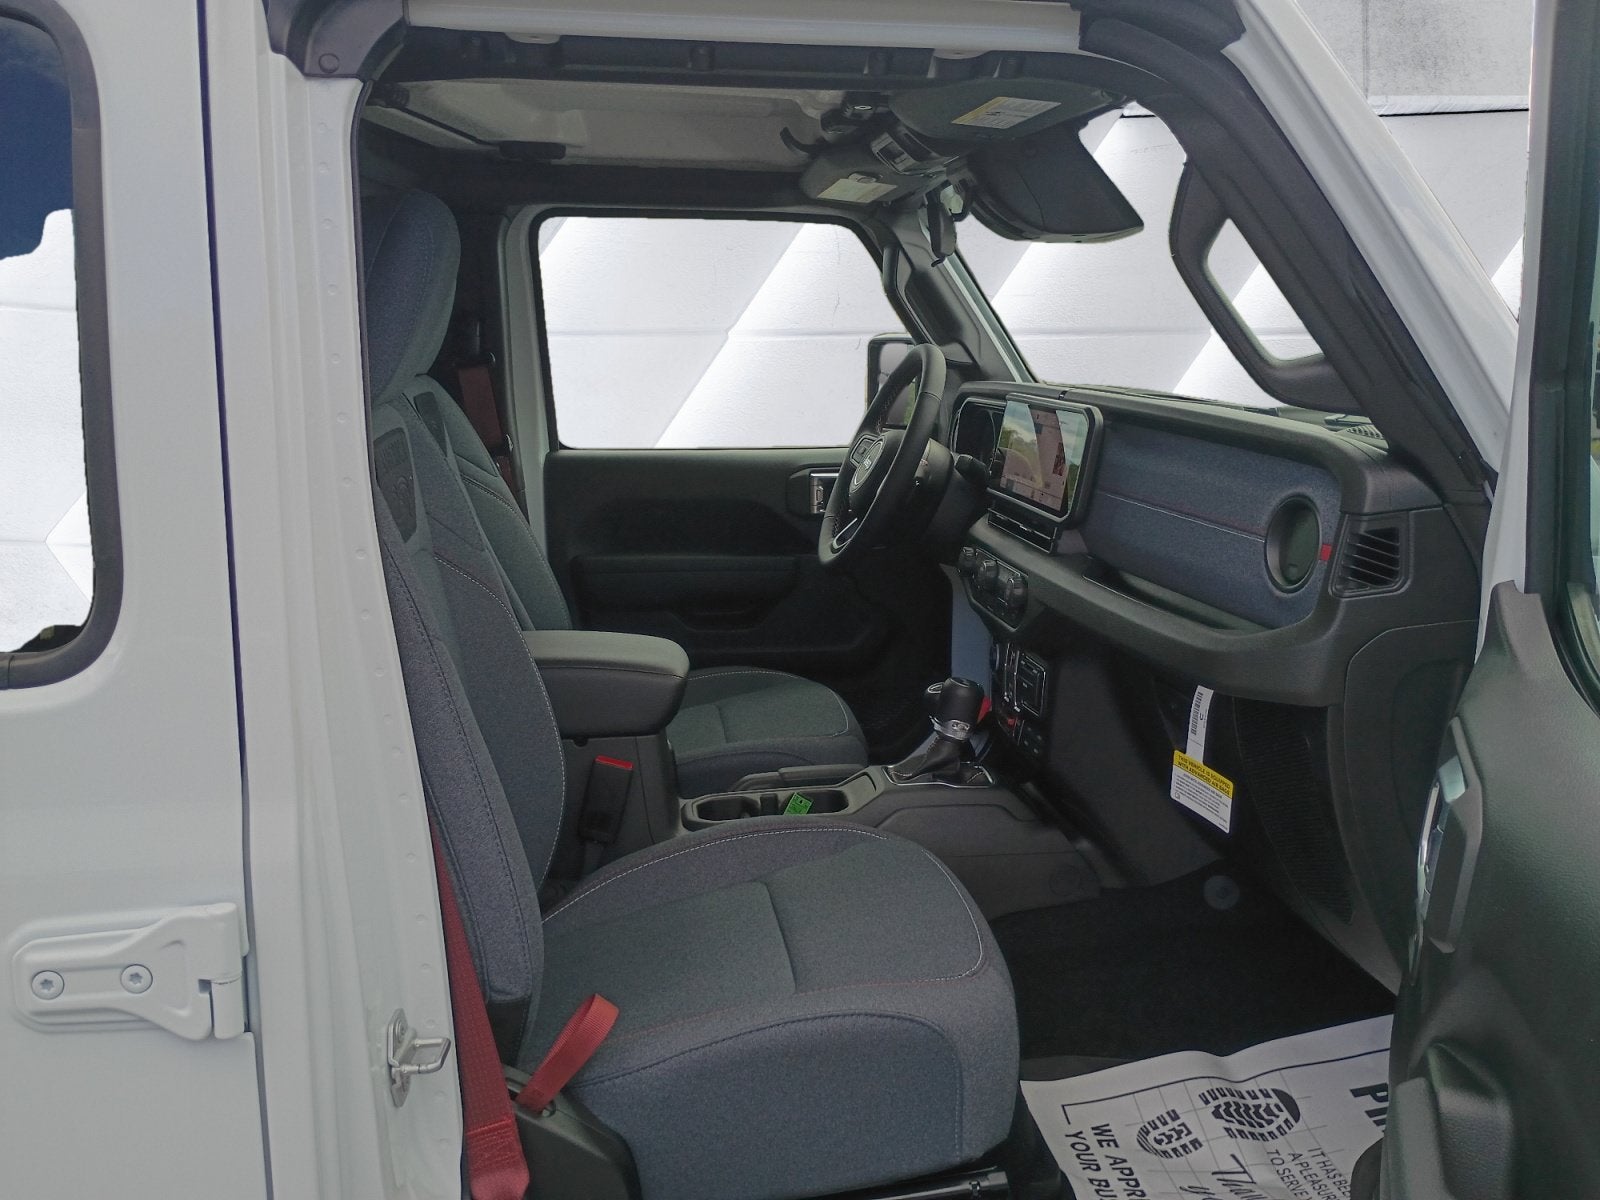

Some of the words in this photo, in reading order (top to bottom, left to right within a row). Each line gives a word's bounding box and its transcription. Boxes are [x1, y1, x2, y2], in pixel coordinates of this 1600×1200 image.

[1065, 1131, 1101, 1172] YOUR
[1088, 1177, 1117, 1200] BU
[1091, 1123, 1119, 1148] WE
[1105, 1155, 1150, 1200] APPR
[1288, 1152, 1303, 1162] A
[1308, 1147, 1326, 1158] IT
[1316, 1160, 1342, 1179] HAS
[1267, 1149, 1285, 1166] TO
[1276, 1167, 1309, 1197] SERVE
[1295, 1161, 1339, 1200] PLEASUR
